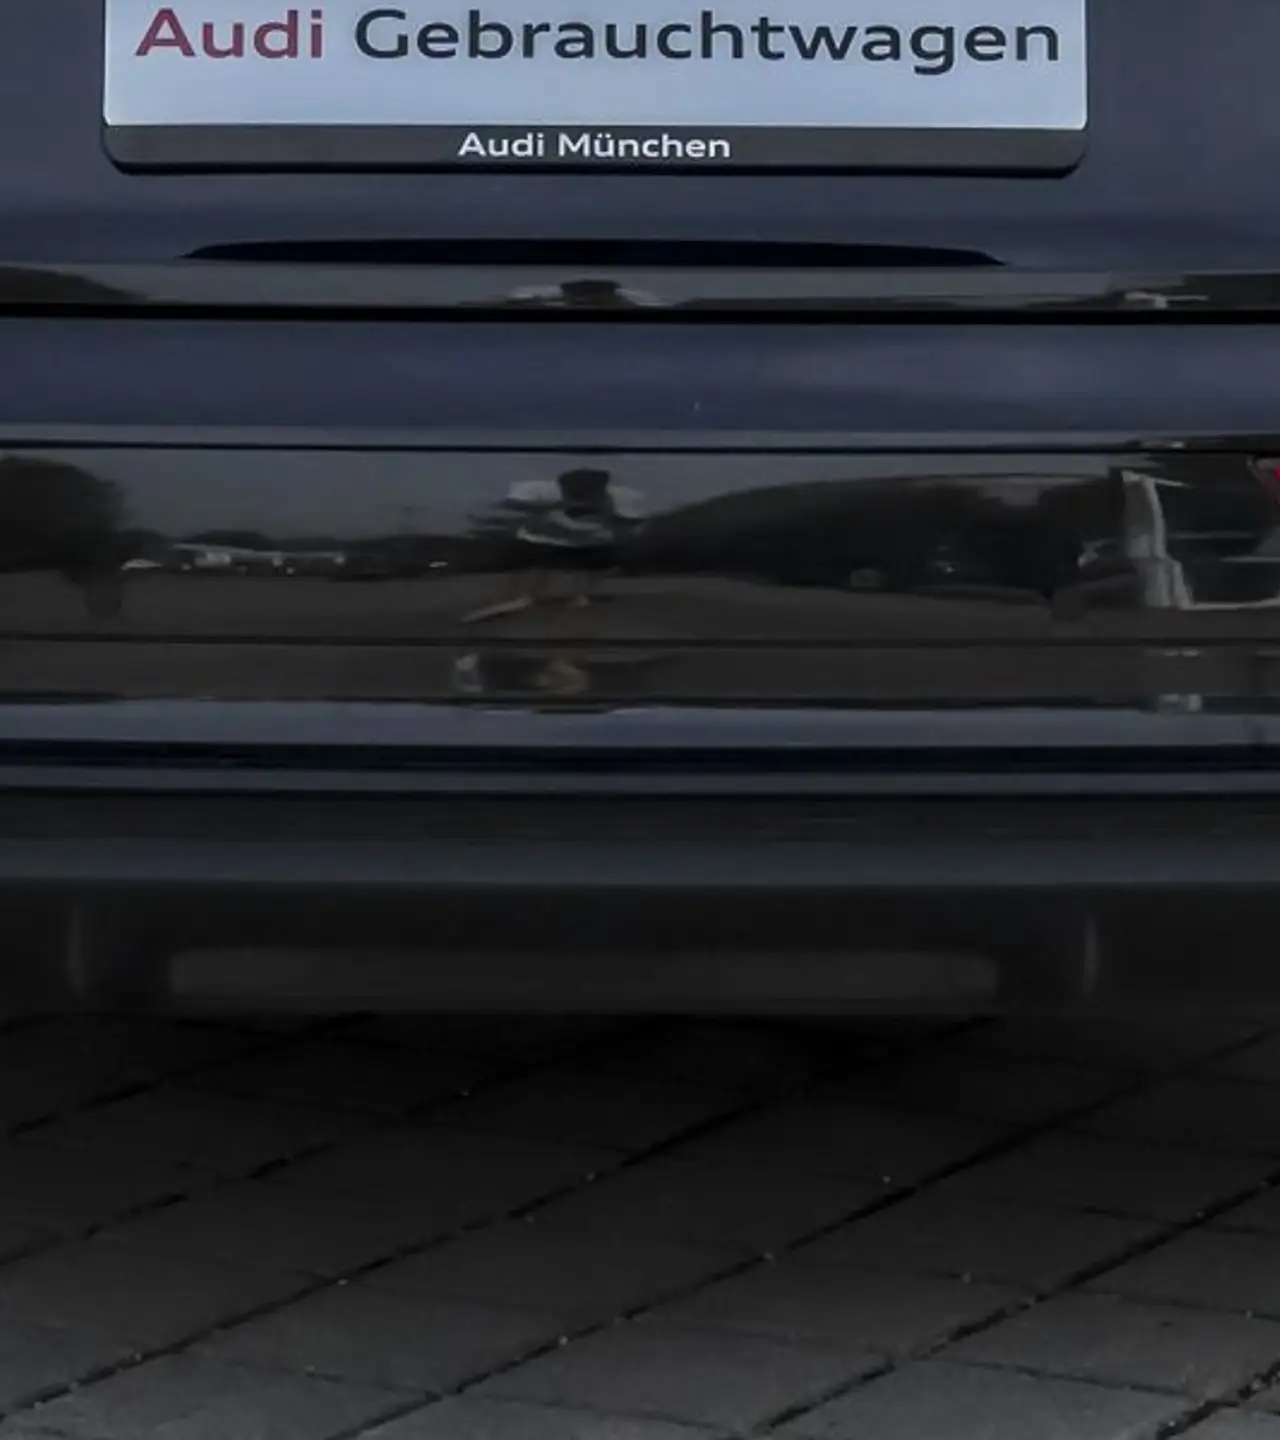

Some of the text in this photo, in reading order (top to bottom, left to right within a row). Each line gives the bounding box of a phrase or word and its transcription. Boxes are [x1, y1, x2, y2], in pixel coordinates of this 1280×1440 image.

[133, 6, 1061, 77] Audi Gebrauchtwagen
[456, 131, 732, 160] Audi München
